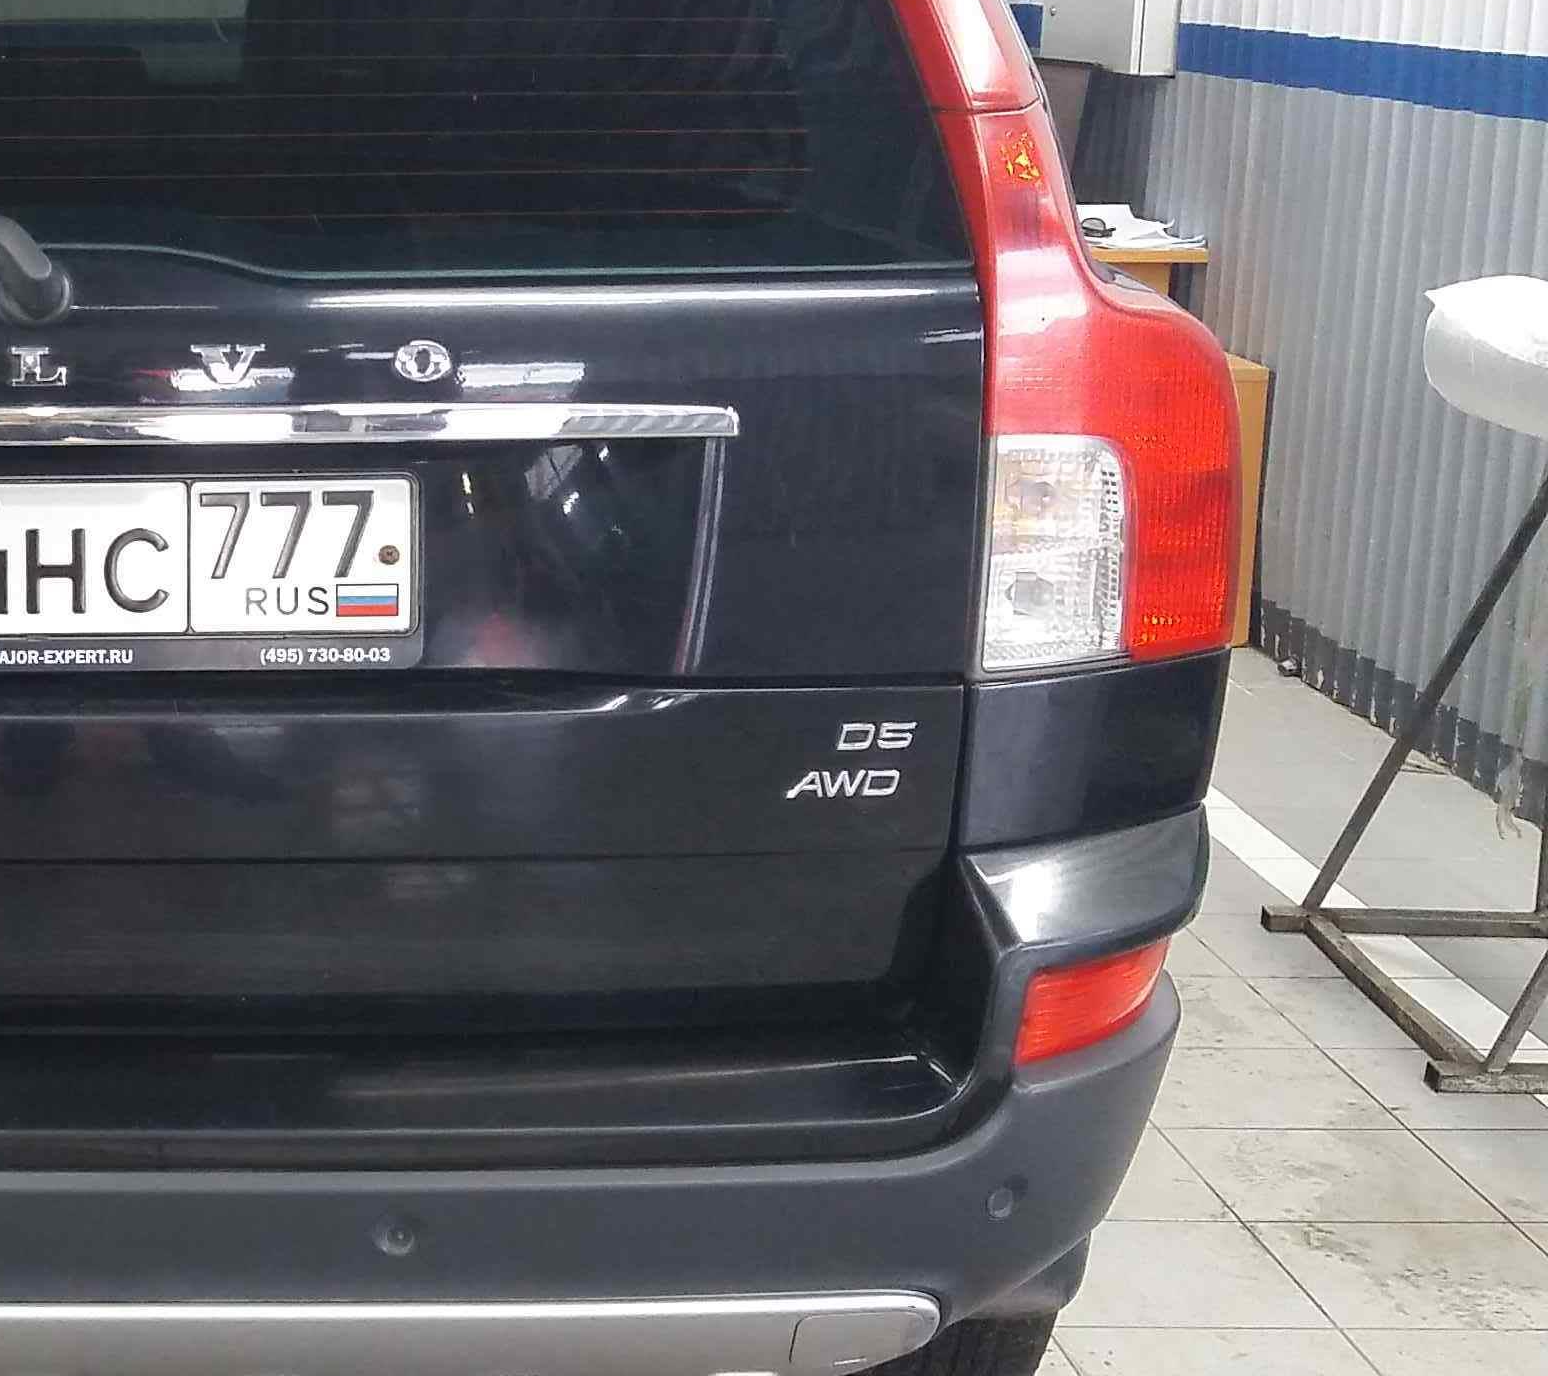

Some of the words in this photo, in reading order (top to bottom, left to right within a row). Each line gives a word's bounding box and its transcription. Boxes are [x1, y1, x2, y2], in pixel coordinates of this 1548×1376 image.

[199, 490, 375, 580] 777
[245, 586, 330, 616] RUS
[260, 647, 303, 666] (495)
[306, 647, 391, 663] 730-80-03
[836, 721, 918, 751] D5
[785, 769, 901, 799] AWD
